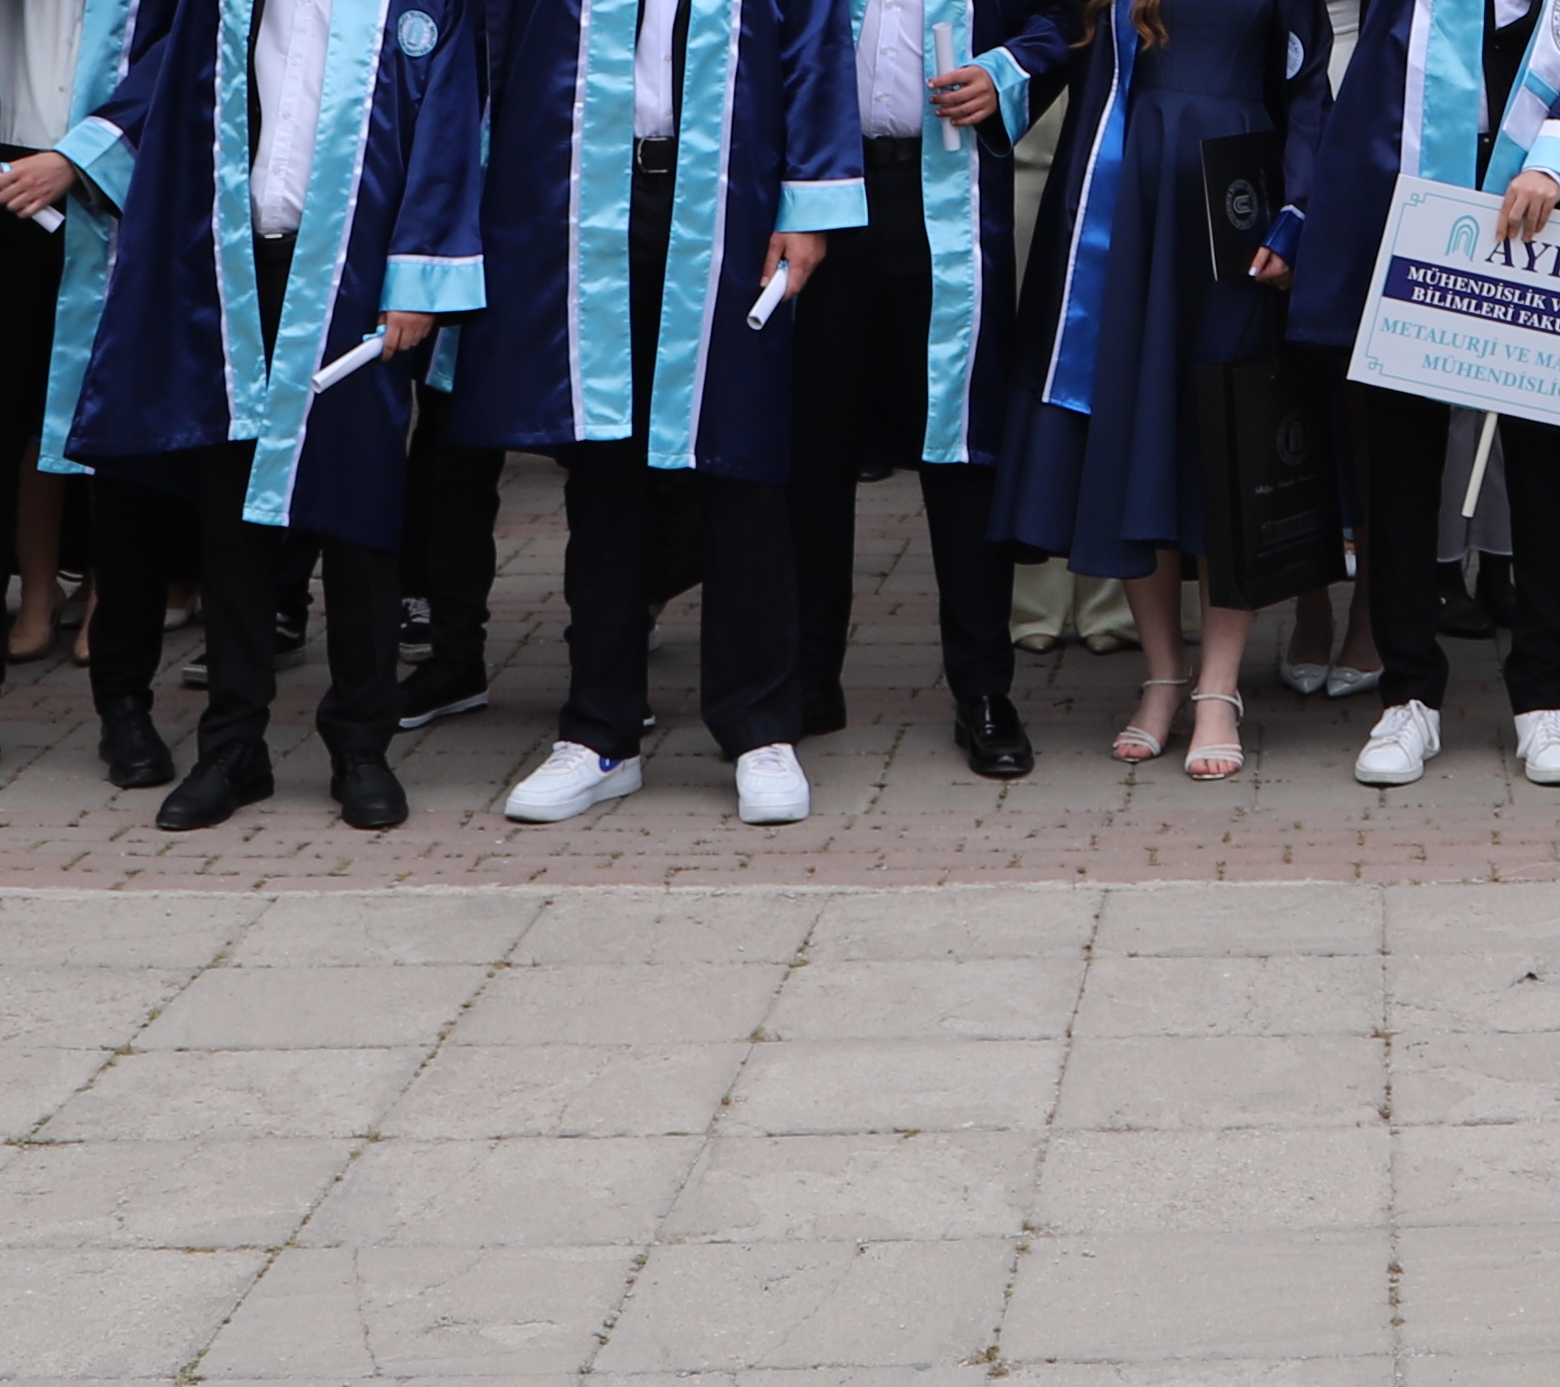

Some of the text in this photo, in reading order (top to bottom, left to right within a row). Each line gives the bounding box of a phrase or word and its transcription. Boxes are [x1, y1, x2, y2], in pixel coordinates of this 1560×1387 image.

[1407, 265, 1547, 310] MÜHENDİSLİK
[1411, 286, 1515, 322] BİLİMLERİ
[1379, 316, 1499, 359] METALURJİ
[1504, 344, 1531, 364] VE
